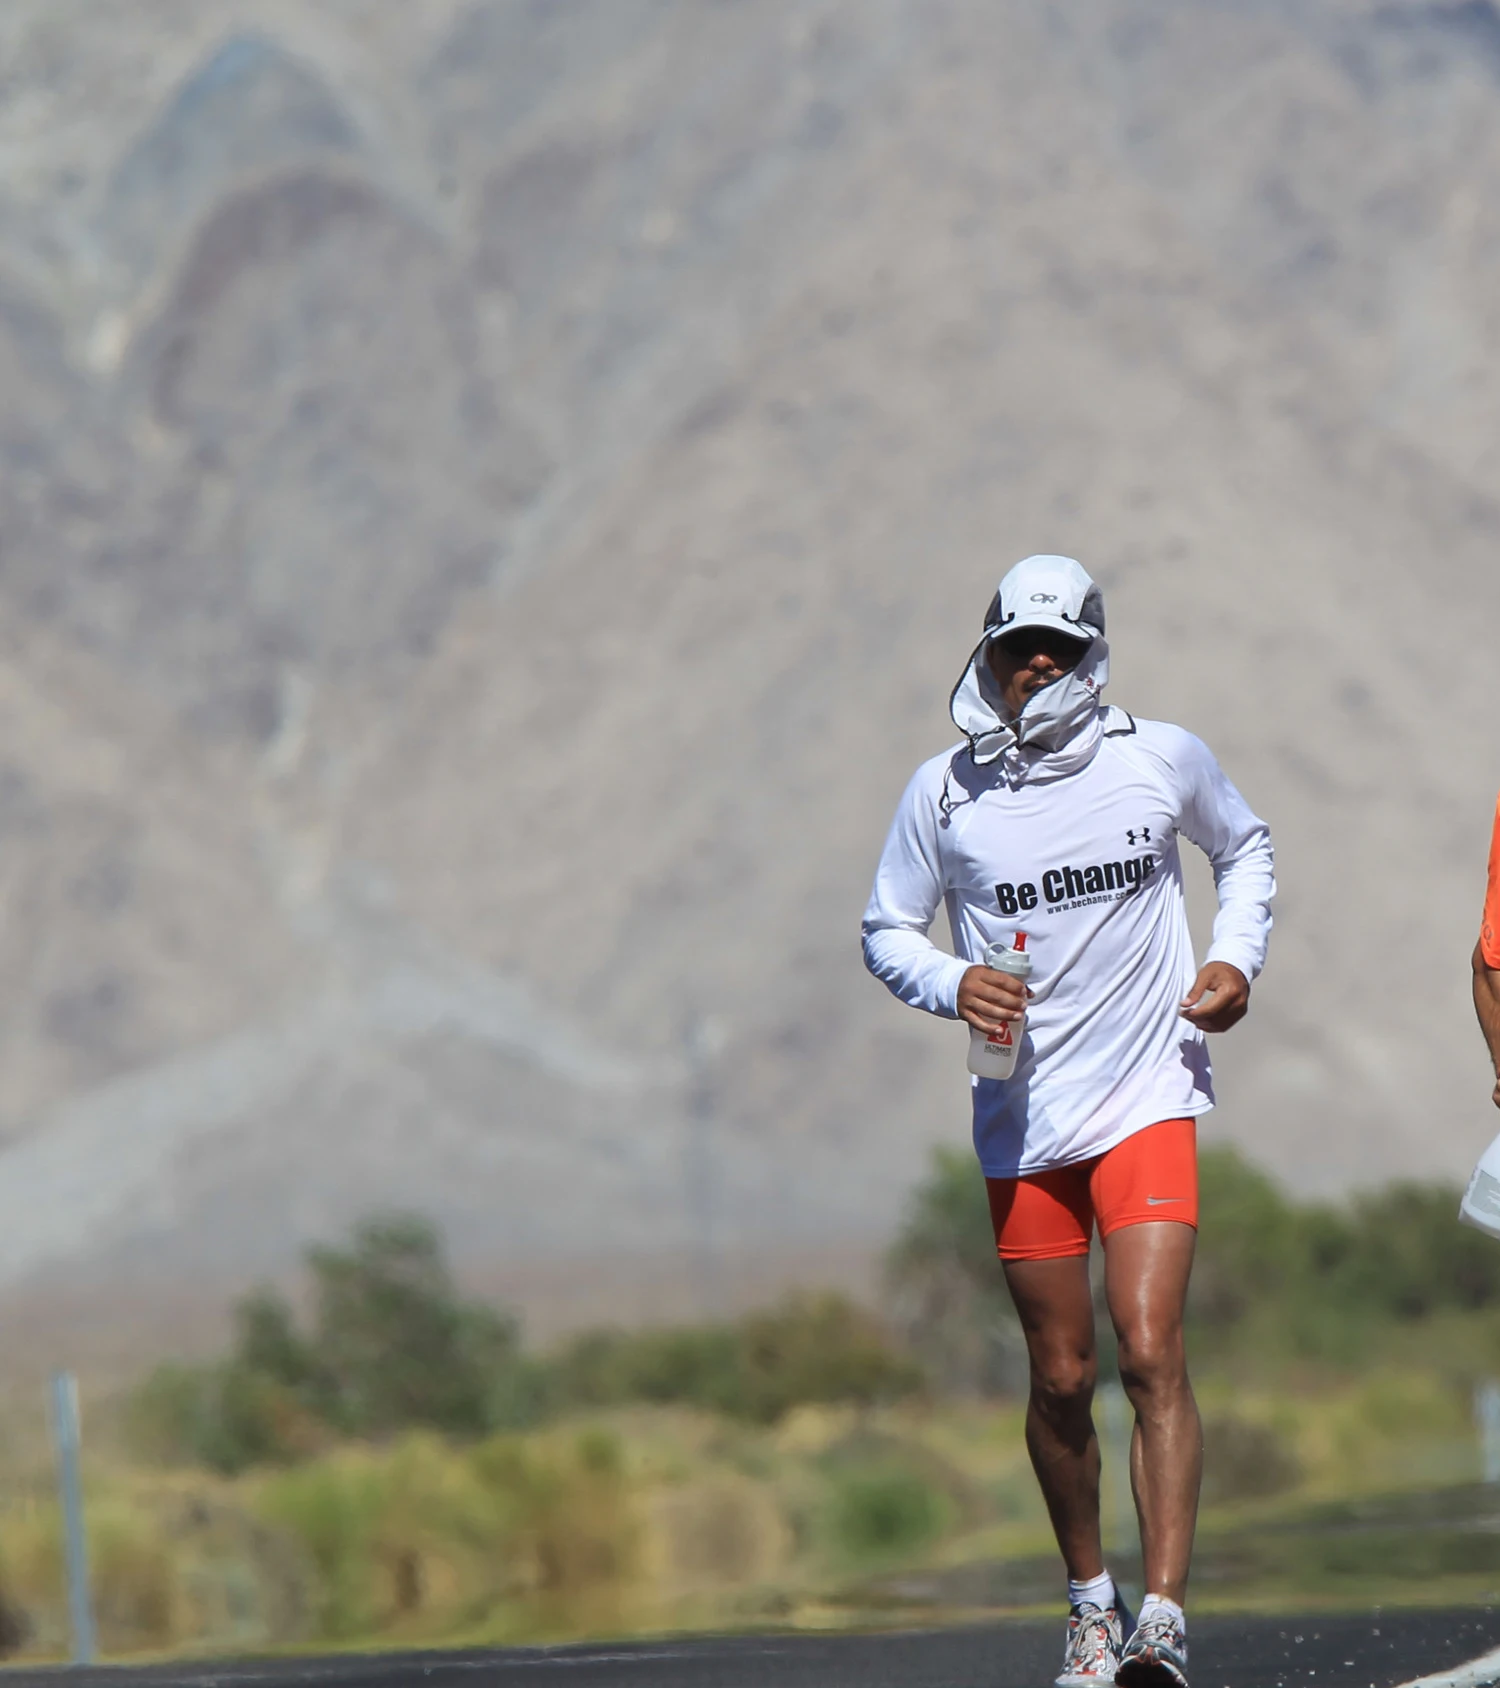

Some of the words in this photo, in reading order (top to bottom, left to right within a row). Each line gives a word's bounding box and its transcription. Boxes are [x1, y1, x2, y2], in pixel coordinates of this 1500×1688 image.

[995, 882, 1038, 915] Be
[1042, 854, 1156, 904] Change
[1046, 892, 1126, 915] www.bechange.co
